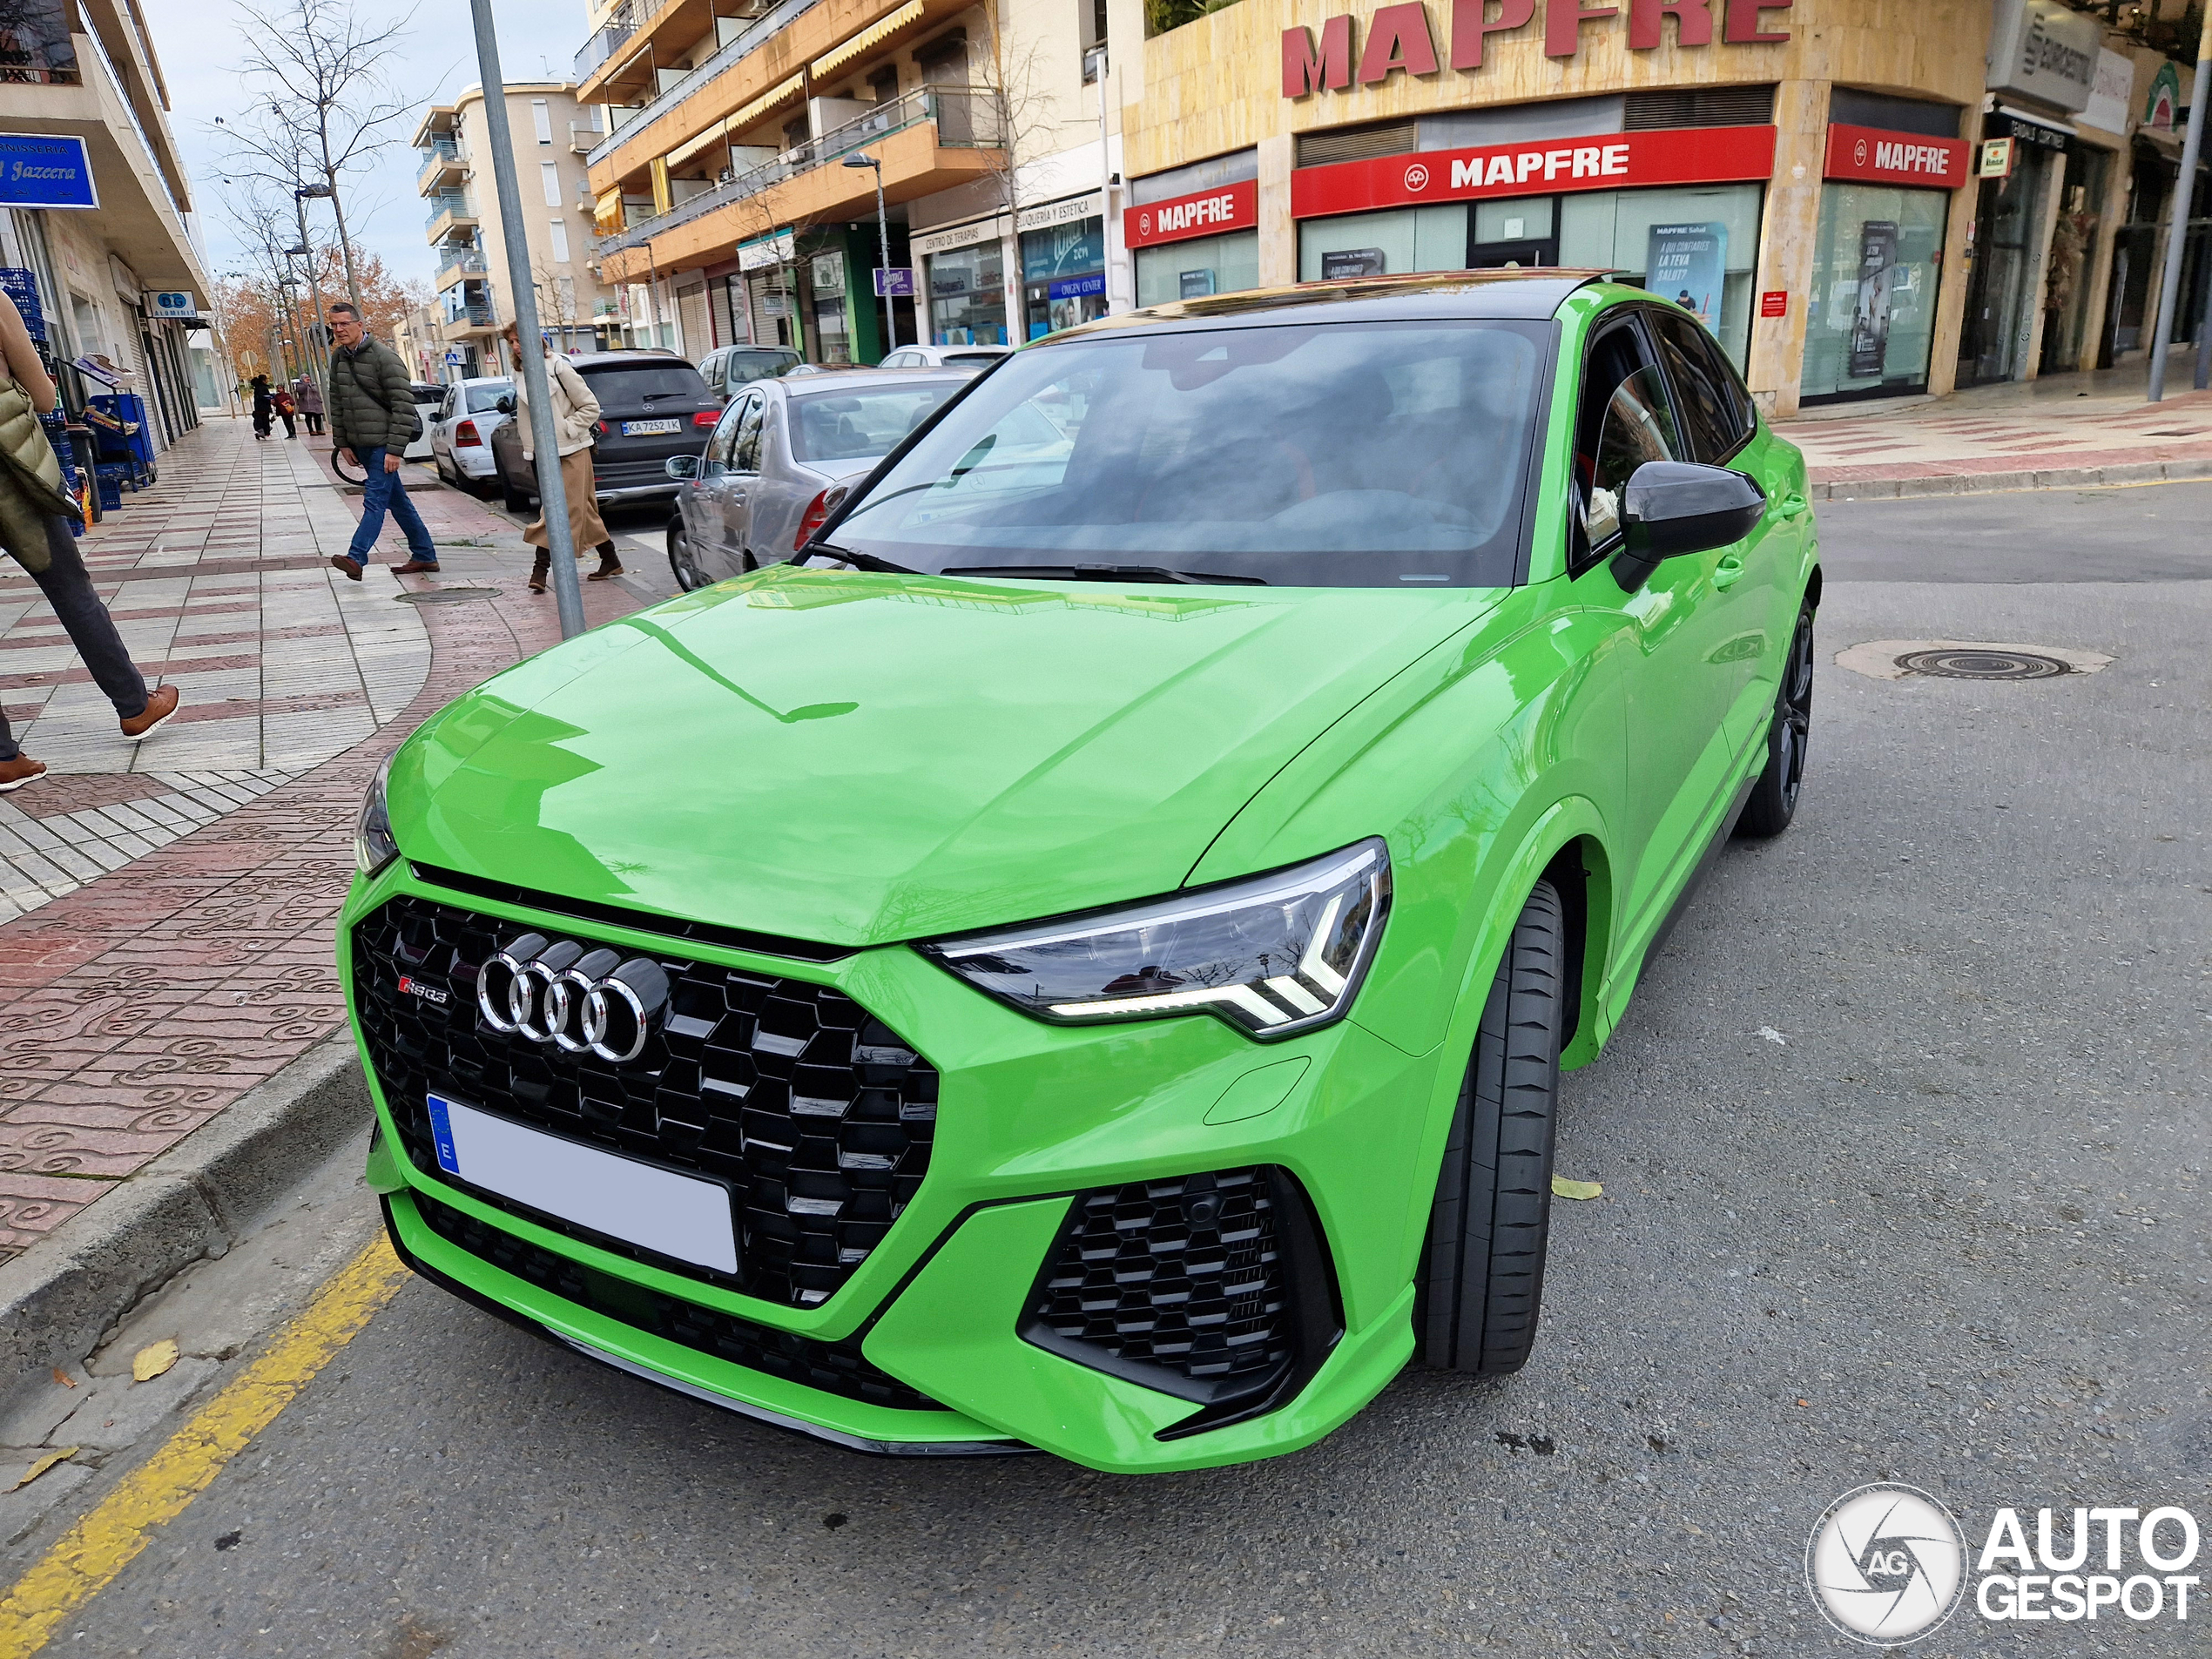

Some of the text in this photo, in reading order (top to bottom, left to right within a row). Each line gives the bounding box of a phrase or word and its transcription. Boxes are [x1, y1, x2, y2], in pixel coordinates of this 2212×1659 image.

[1283, 0, 1792, 98] MAPFRE
[1450, 144, 1630, 189] MAPFRE
[1875, 140, 1950, 175] MAPFRE
[11, 160, 76, 181] Jazeera
[1053, 210, 1058, 220] Y
[1059, 200, 1089, 219] ESTÉTICA
[1157, 193, 1234, 233] MAPFRE
[926, 227, 980, 250] CENTRO DE TERAPIAS
[1658, 253, 1689, 267] LA TEVA
[1657, 269, 1688, 282] SALUT?
[1082, 279, 1102, 293] CENTER
[629, 420, 679, 433] KA 7252 IK
[441, 1142, 452, 1160] E
